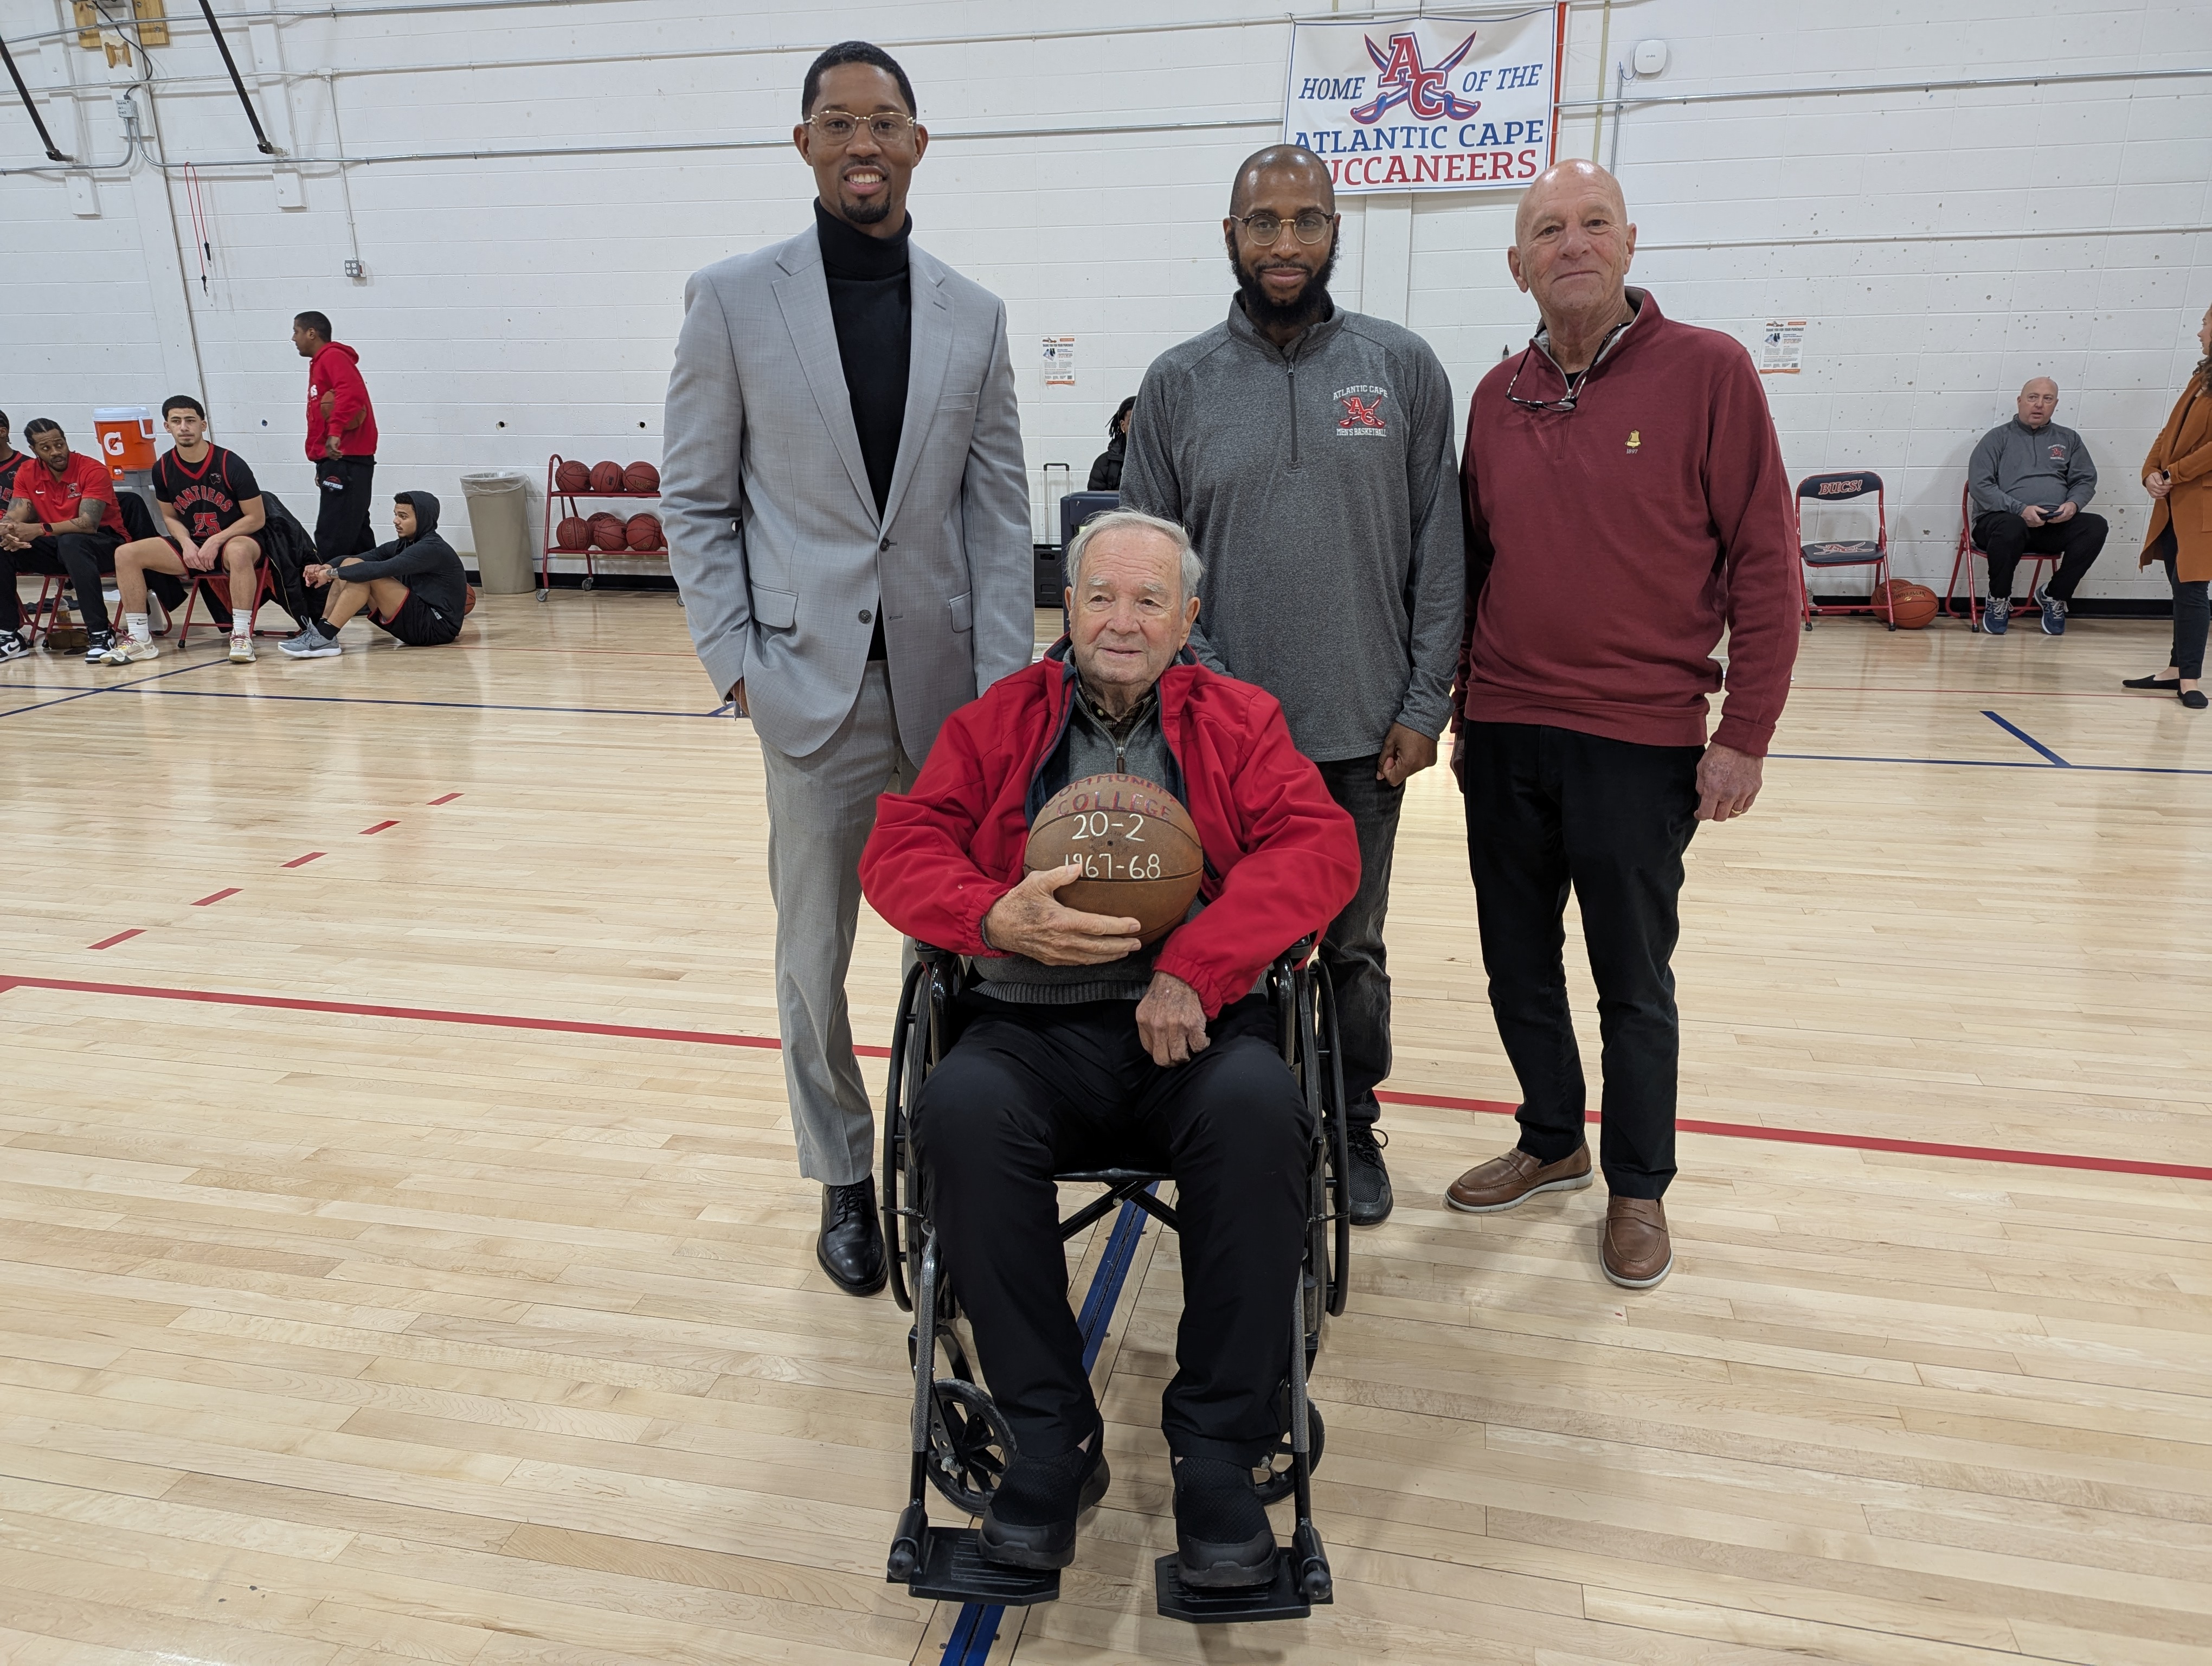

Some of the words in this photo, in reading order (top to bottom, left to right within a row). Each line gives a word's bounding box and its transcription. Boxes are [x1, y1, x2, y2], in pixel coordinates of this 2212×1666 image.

[1298, 76, 1366, 100] HOME
[1462, 70, 1493, 93] OF
[1496, 63, 1544, 90] THE
[1295, 125, 1449, 153] ATLANTIC
[1458, 119, 1544, 148] CAPE
[1323, 149, 1536, 185] UCCANEERS
[1333, 385, 1368, 400] ATLANTIC
[1369, 386, 1388, 398] CAPE
[104, 432, 125, 456] G
[1354, 428, 1387, 437] BASKETBALL
[1818, 479, 1863, 495] BUCS!
[193, 512, 221, 536] 25
[1045, 774, 1179, 809] COMMUNITY
[1057, 791, 1171, 822] COLLEGE
[1072, 811, 1145, 842] 20-2
[1065, 853, 1161, 880] 1967-68
